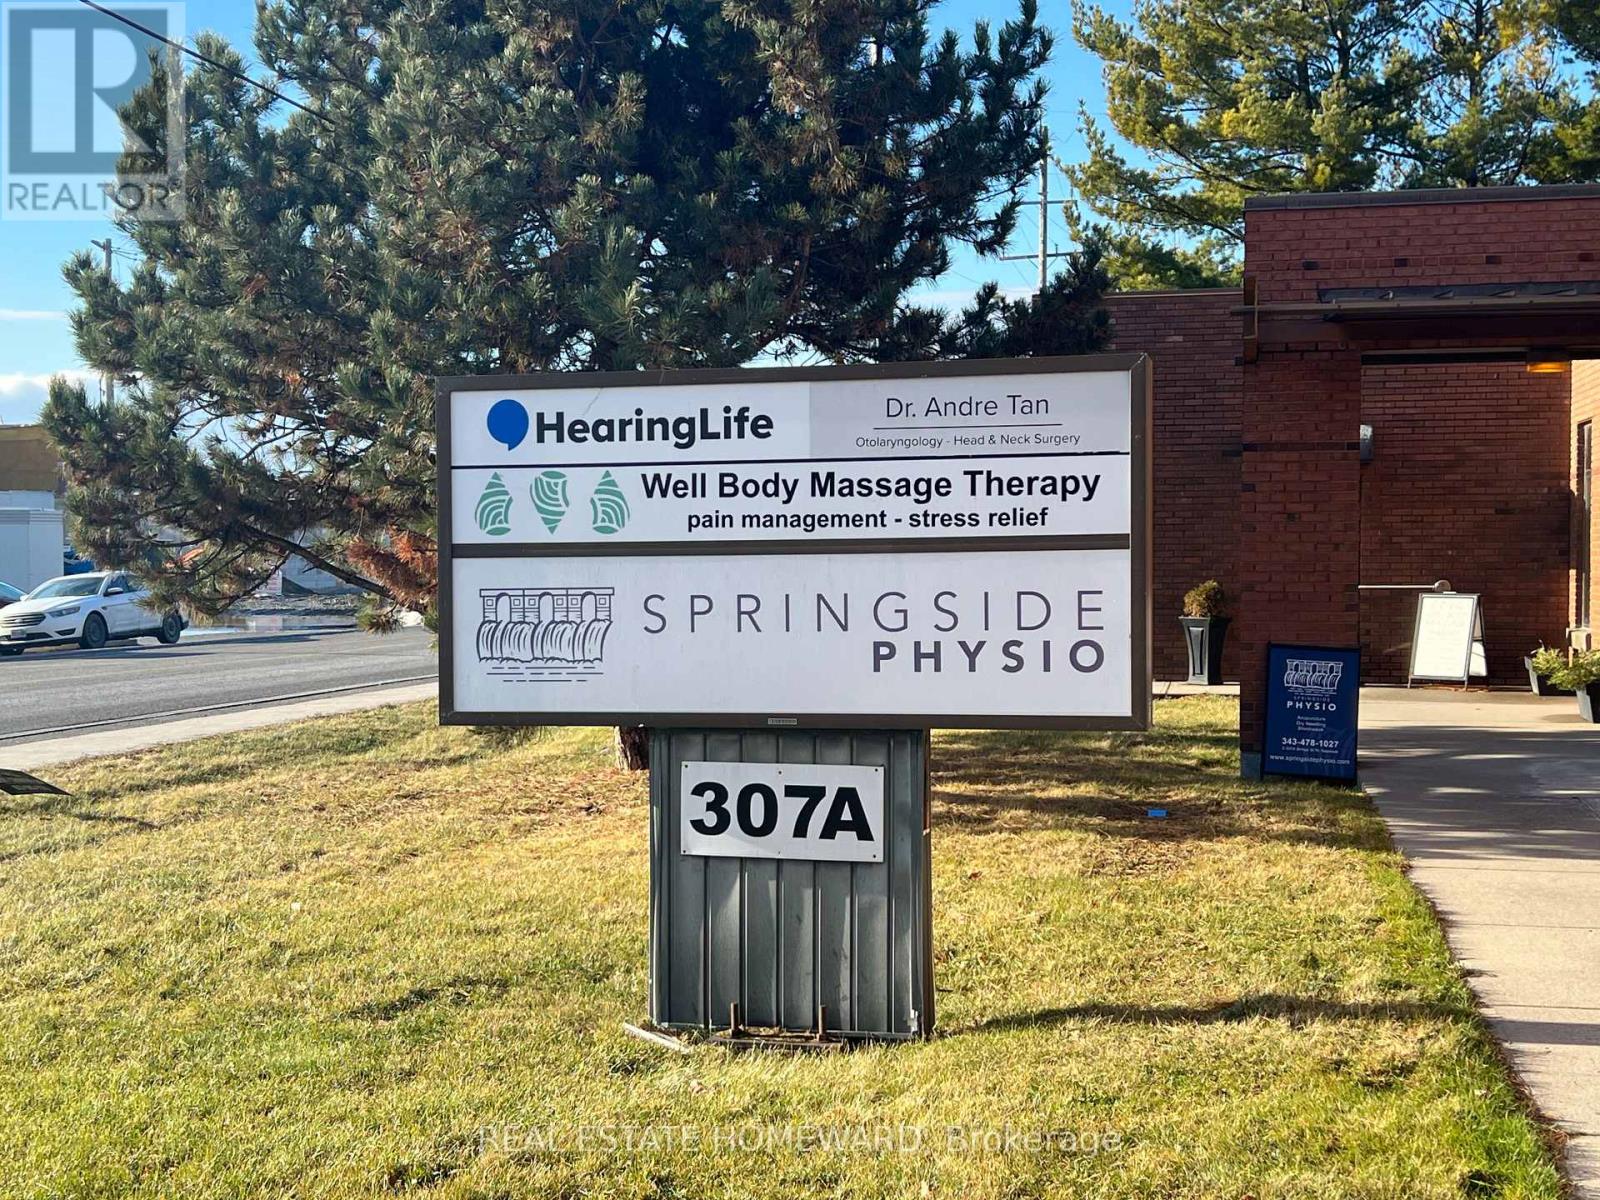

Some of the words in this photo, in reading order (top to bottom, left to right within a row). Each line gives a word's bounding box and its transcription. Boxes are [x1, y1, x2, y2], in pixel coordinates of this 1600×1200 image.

[886, 397, 917, 418] Dr.
[924, 396, 998, 417] Andre
[1006, 394, 1049, 415] Tan
[536, 405, 774, 450] HearingLife
[855, 436, 943, 449] Otolaryngology
[954, 434, 985, 446] Head
[988, 434, 996, 445] &
[1000, 433, 1031, 445] Neck
[1034, 432, 1081, 446] Surgery
[641, 472, 707, 499] Well
[718, 471, 799, 504] Body
[810, 471, 952, 504] Massage
[963, 470, 1101, 502] Therapy
[688, 510, 733, 532] pain
[741, 510, 887, 532] management
[908, 508, 980, 528] stress
[988, 507, 1049, 527] relief
[643, 590, 1105, 634] SPRINGSIDE
[872, 639, 1105, 673] PHYSIO
[1286, 700, 1337, 711] PHYSIO
[1281, 737, 1339, 748] 343-478-1027
[689, 781, 875, 842] 307A
